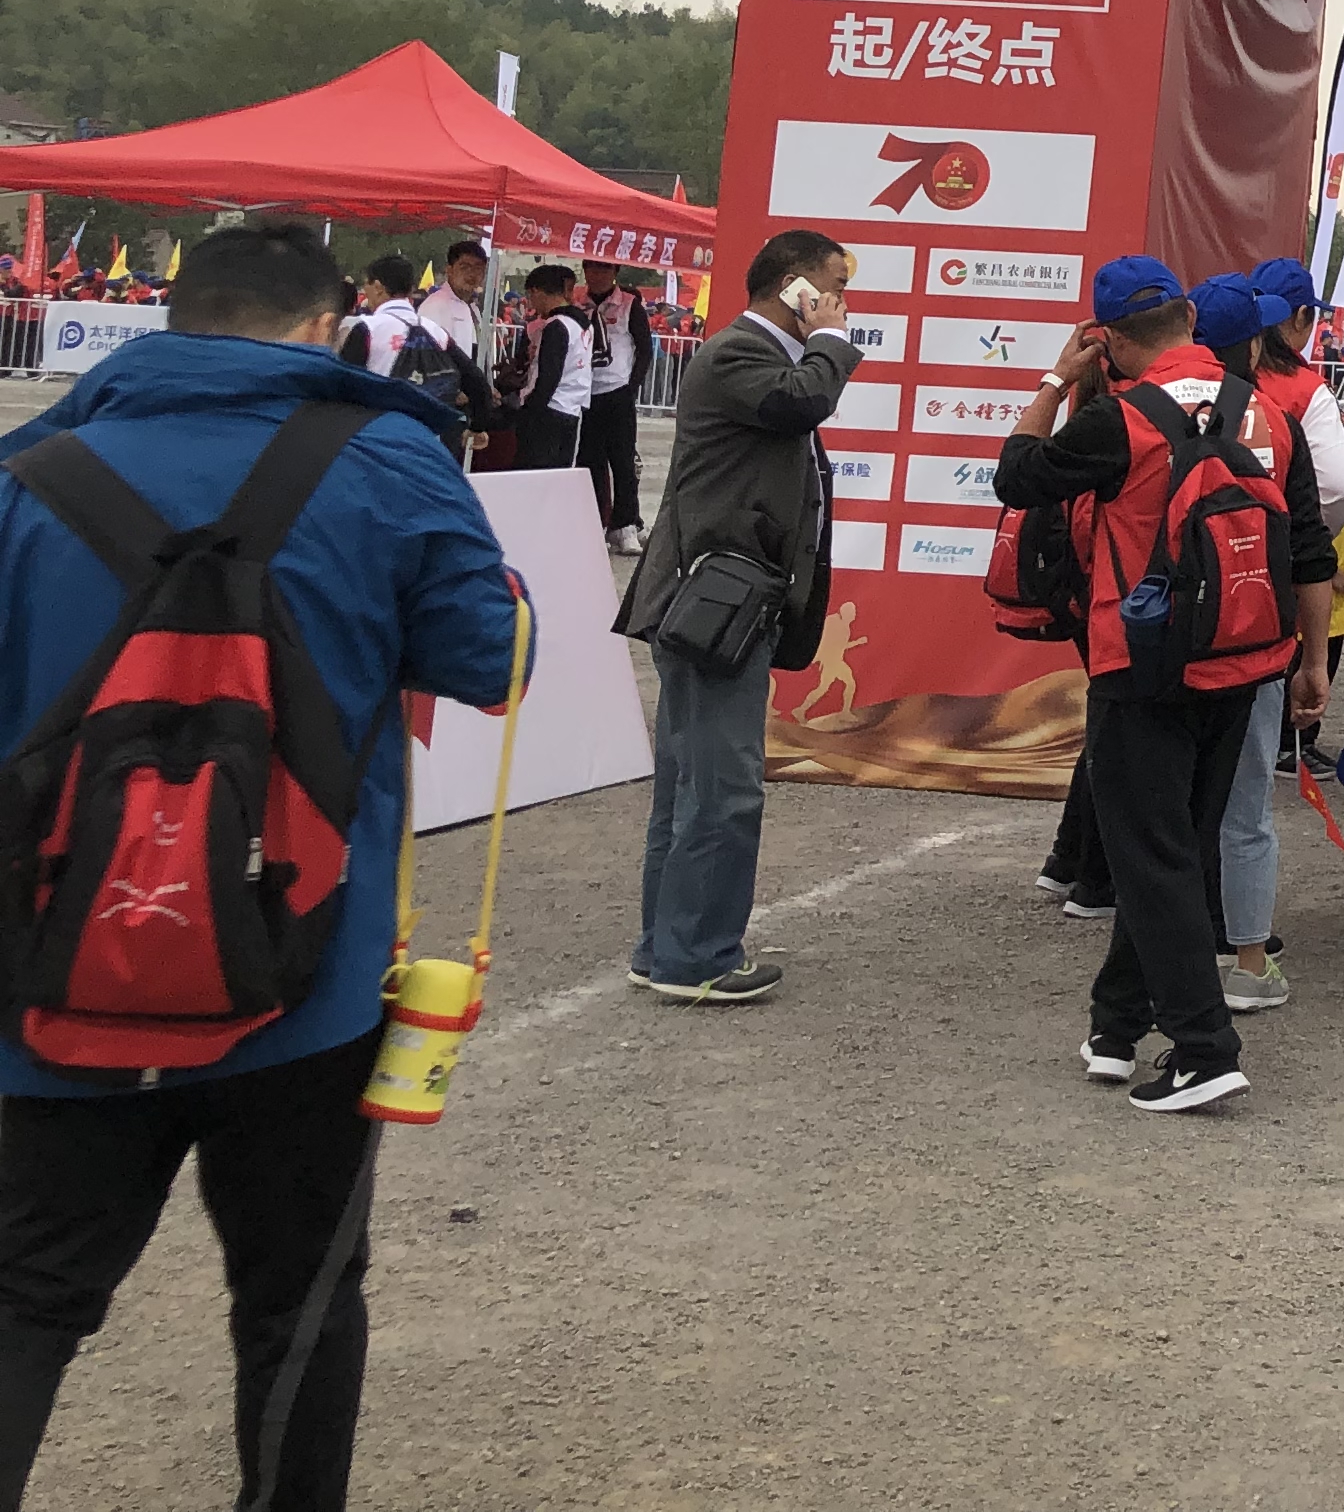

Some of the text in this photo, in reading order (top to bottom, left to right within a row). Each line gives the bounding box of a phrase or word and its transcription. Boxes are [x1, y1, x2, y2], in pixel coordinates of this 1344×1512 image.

[827, 11, 1061, 88] 起/终点
[569, 222, 678, 266] 医疗服务区
[974, 261, 1070, 280] 繁昌农商银行
[89, 325, 160, 340] 太平洋保
